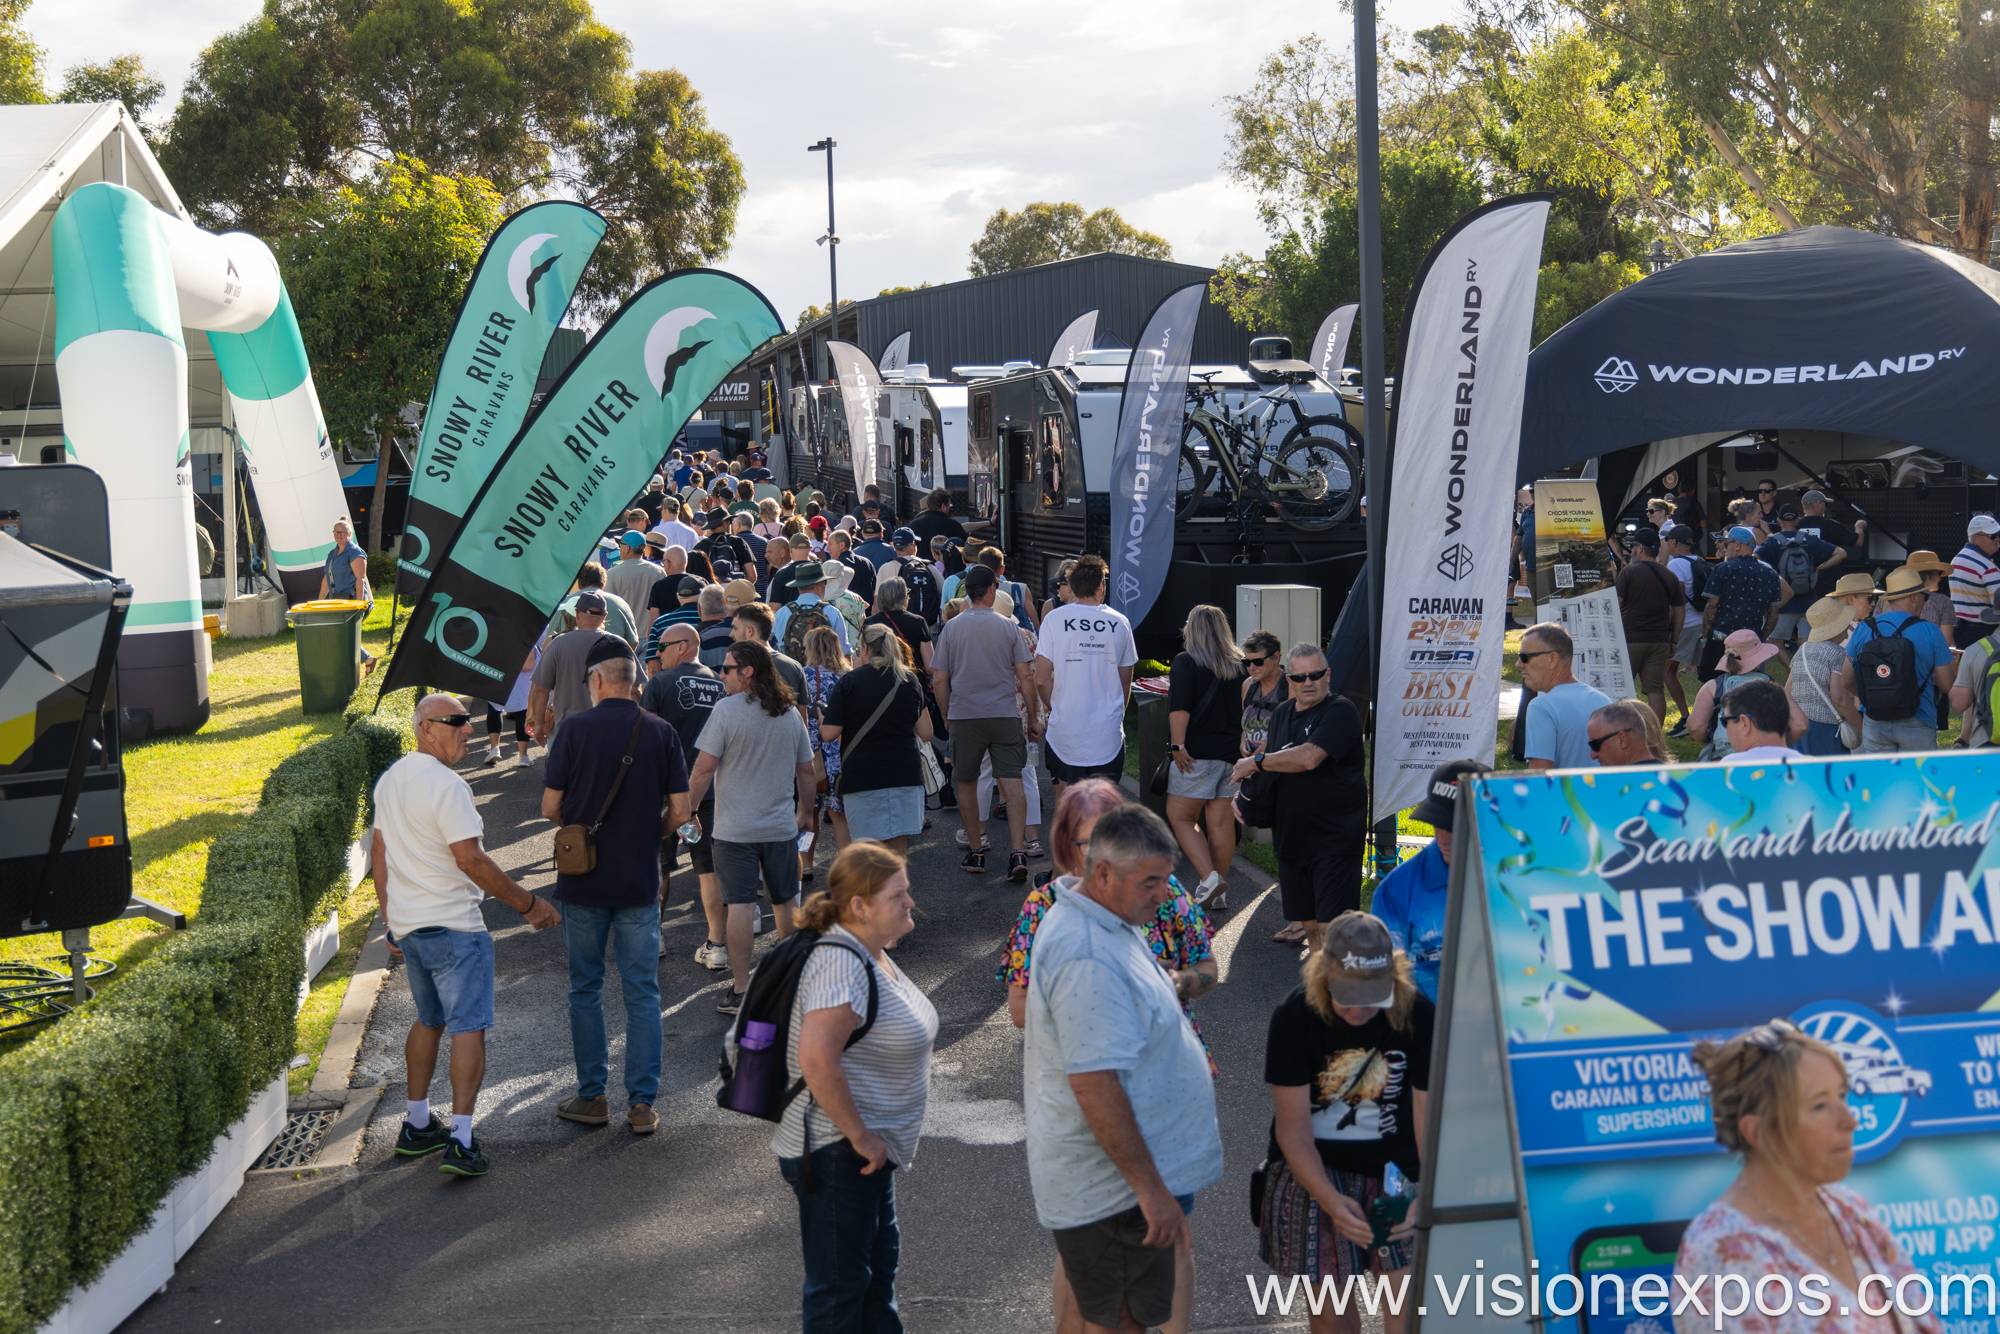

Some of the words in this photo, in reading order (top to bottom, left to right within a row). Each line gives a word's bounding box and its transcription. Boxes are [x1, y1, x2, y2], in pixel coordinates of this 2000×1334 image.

[1648, 352, 1936, 385] WONDERLAND
[1938, 346, 1967, 361] RV
[426, 395, 478, 483] SNOWY
[466, 311, 517, 385] RIVER
[714, 382, 750, 396] IVID
[1445, 285, 1482, 537] WONDERLAND
[1466, 258, 1478, 282] RV
[472, 371, 514, 447] CARAVANS
[494, 463, 570, 558] SNOWY
[563, 379, 641, 464] RIVER
[558, 455, 616, 533] CARAVANS
[1408, 597, 1484, 615] CARAVAN
[424, 592, 489, 658] 10
[1064, 618, 1119, 633] KSCY
[451, 652, 504, 681] ANNIVERSARY
[689, 679, 720, 692] Sweet
[698, 692, 712, 703] As
[1402, 671, 1477, 701] BEST
[1401, 701, 1473, 718] OVERALL
[1598, 815, 1720, 880] Scan
[1722, 811, 1812, 861] and
[1812, 802, 2000, 856] download
[1530, 887, 1693, 971] THE
[1703, 871, 1922, 962] SHOW
[1960, 1060, 1993, 1086] TO
[1550, 1085, 1638, 1111] CARAVAN
[1642, 1084, 1655, 1104] &
[1973, 1088, 2000, 1110] EN
[1596, 1103, 1706, 1135] SUPERSHOW
[1875, 1194, 1999, 1229] OWNLOAD
[1944, 1225, 1995, 1255] APP
